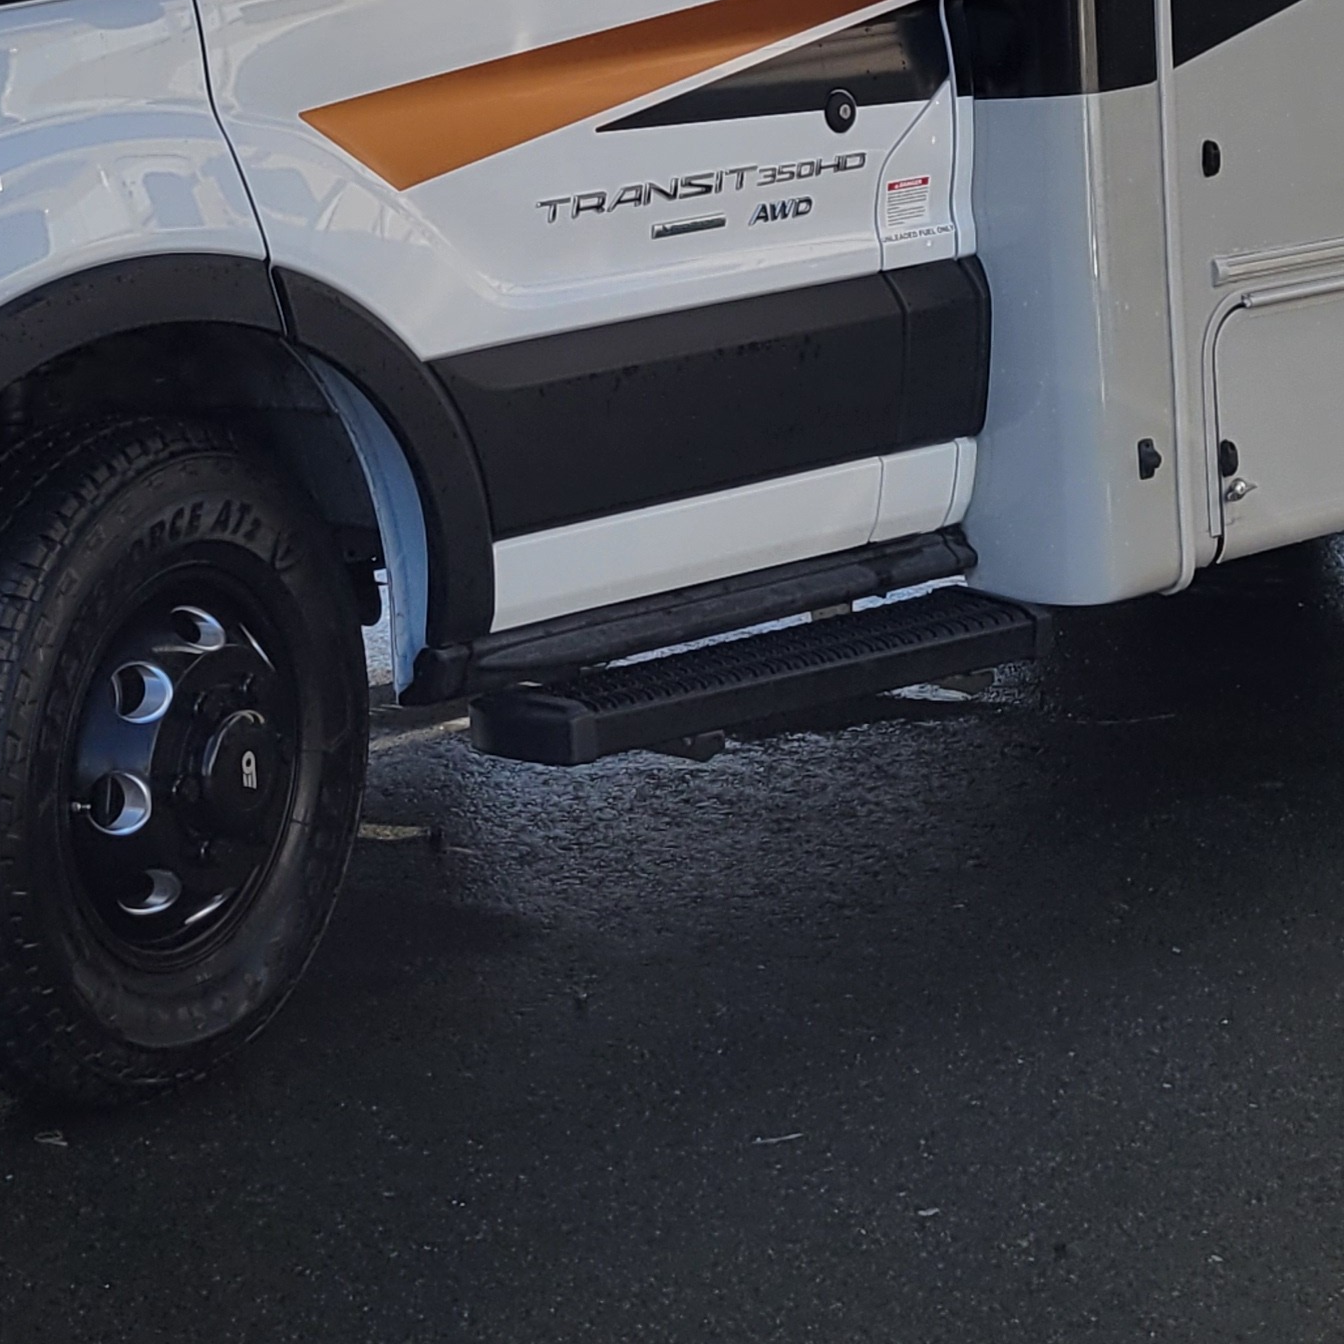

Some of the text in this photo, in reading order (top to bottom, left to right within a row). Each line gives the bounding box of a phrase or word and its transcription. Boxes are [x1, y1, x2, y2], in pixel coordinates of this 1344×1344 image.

[536, 152, 867, 223] TRANSIT 350HD
[748, 196, 813, 227] AWD
[918, 227, 937, 237] FUEL
[936, 224, 955, 234] ONLY
